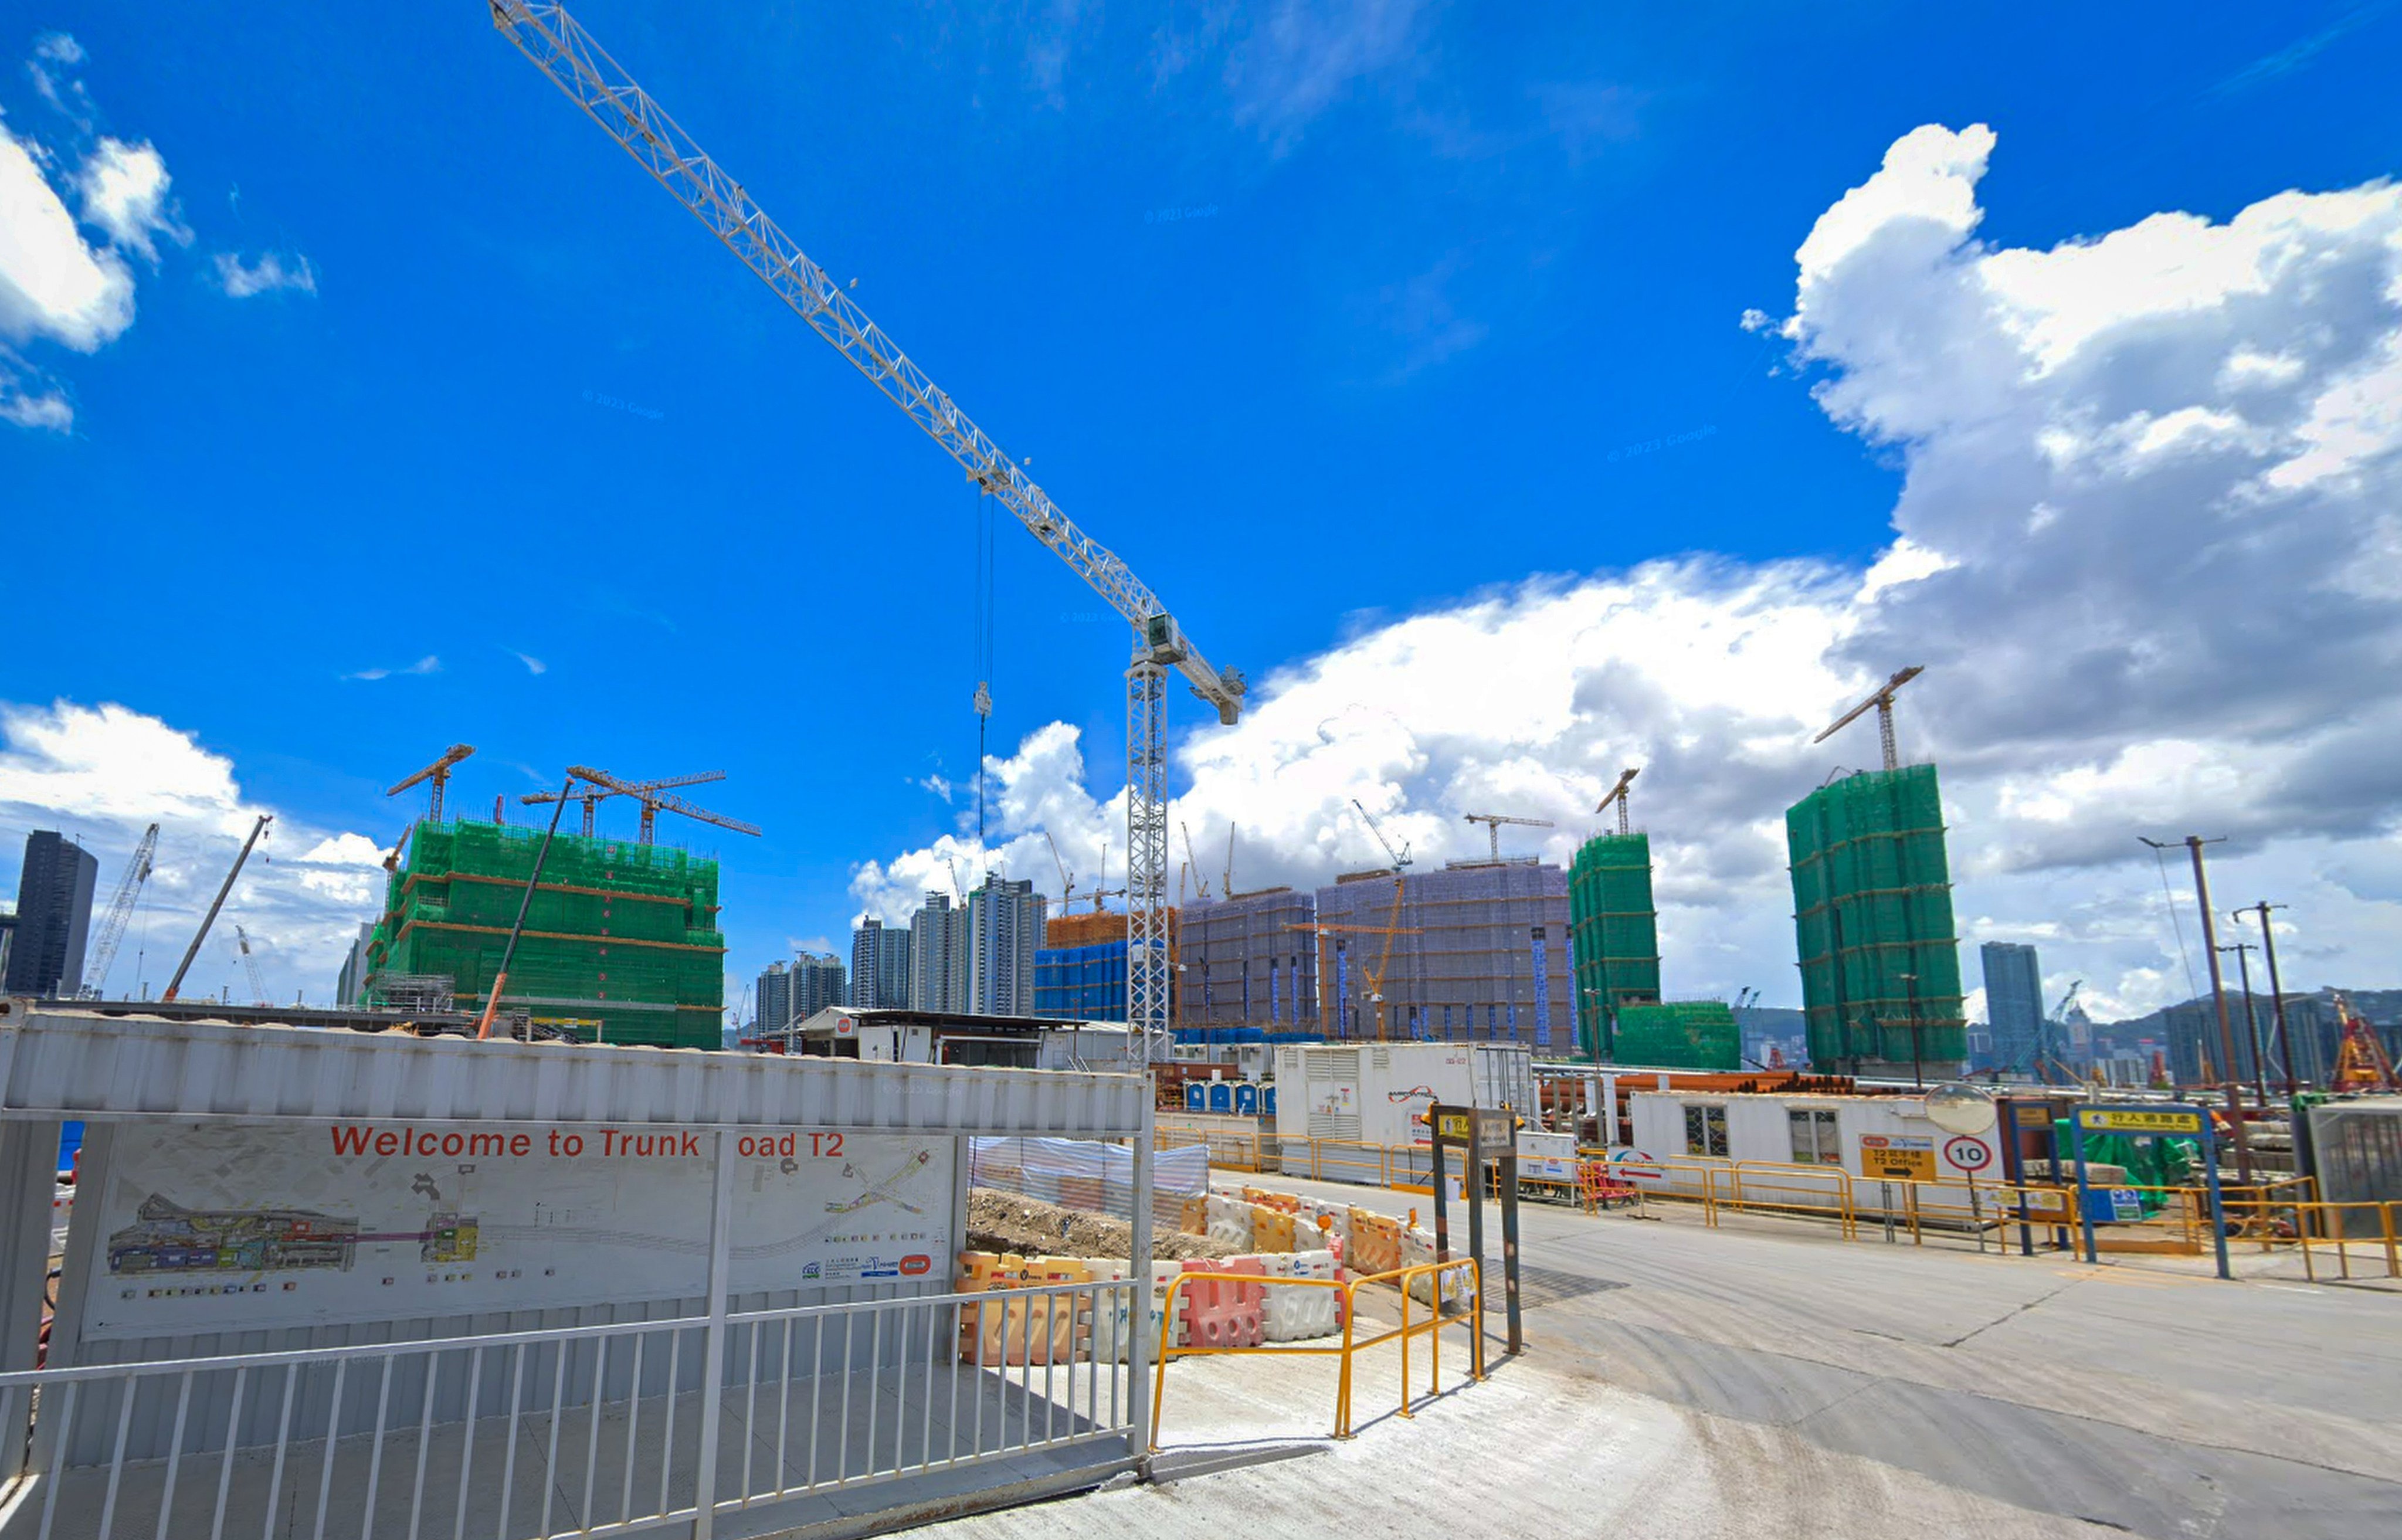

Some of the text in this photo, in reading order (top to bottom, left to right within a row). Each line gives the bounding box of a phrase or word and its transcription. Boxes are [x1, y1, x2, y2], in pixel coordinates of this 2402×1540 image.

[331, 1126, 844, 1157] Welcome to Trunk oad T2
[1956, 1148, 1982, 1161] 10
[1889, 1158, 1923, 1166] Office
